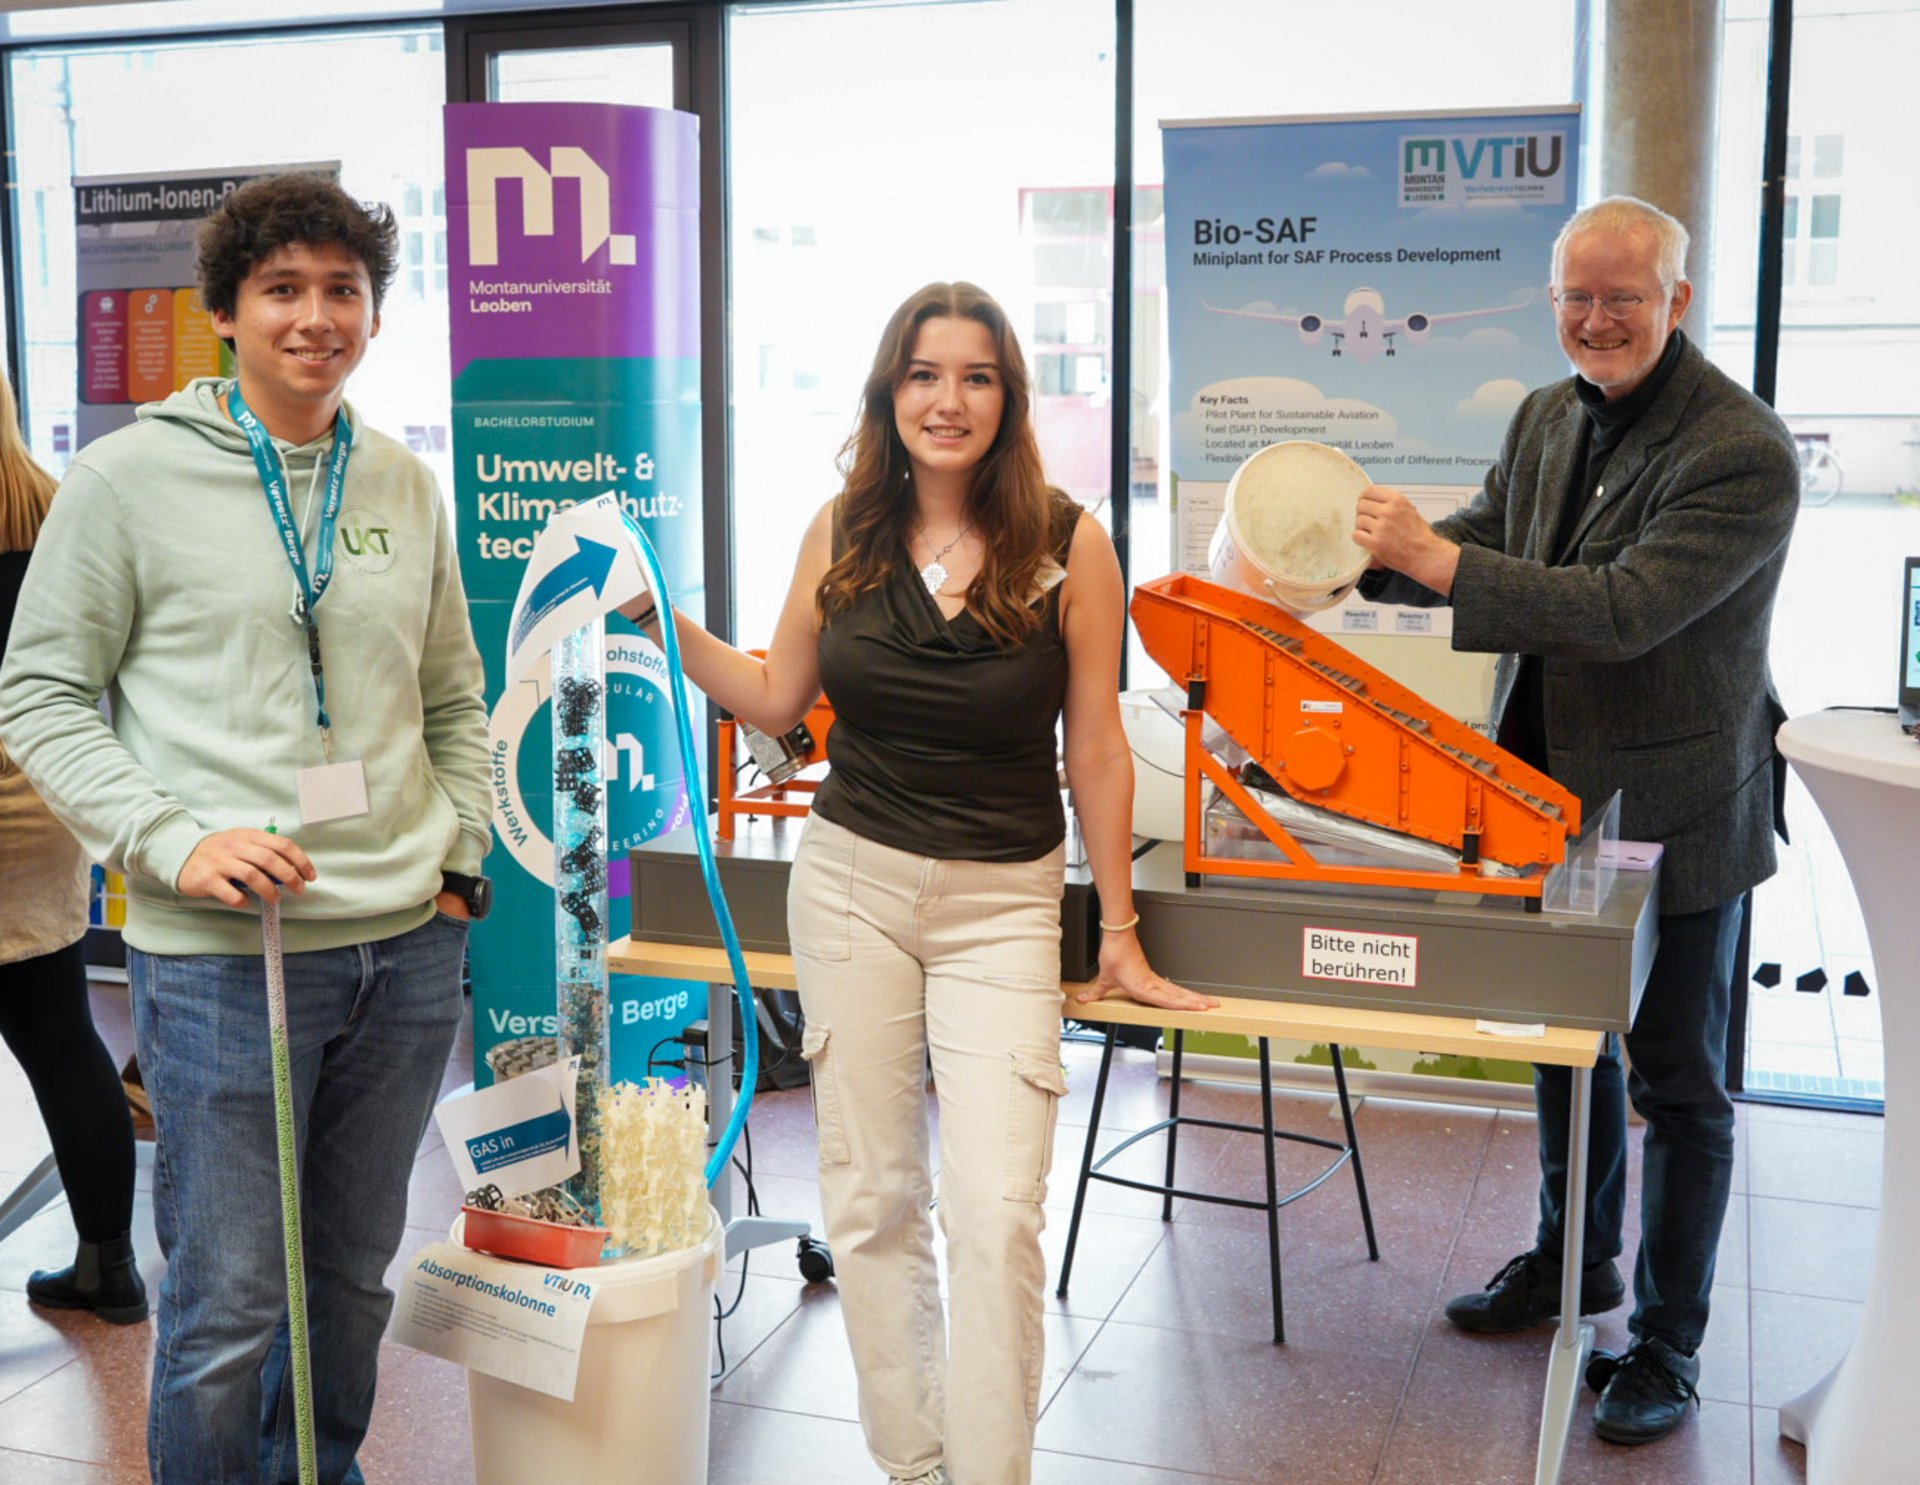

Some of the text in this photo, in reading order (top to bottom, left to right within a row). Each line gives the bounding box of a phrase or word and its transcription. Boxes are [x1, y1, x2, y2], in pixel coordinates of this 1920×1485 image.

[1404, 174, 1445, 184] MONTAN
[80, 181, 238, 214] Lithium-Ionen-B
[1194, 216, 1317, 245] Bio-SAF
[1193, 247, 1502, 268] Miniplant for SAF Process Development
[470, 279, 612, 295] Montanuniversität
[470, 298, 532, 313] Leoben
[1200, 395, 1249, 406] Key Facts
[474, 416, 595, 428] BACHELORSTUDIUM
[1206, 409, 1379, 419] Pilot Plant for Sustainable Aviation
[1206, 424, 1326, 437] Fuel (SAF) Development
[1206, 439, 1245, 449] Located
[1248, 440, 1260, 449] at
[1355, 440, 1394, 450] Leoben
[476, 453, 656, 482] Umwelt- &
[1206, 453, 1243, 463] Flexible
[1394, 454, 1405, 465] of
[1408, 455, 1452, 465] Different
[606, 646, 669, 680] ohstoffe
[491, 738, 529, 848] Werkstoffe
[1311, 933, 1410, 958] Bitte nicht
[1312, 958, 1407, 983] berühren!
[622, 990, 689, 1025] Berge
[470, 1138, 499, 1158] GAS
[498, 1135, 515, 1150] in
[417, 1258, 556, 1318] Absorptionskolonne
